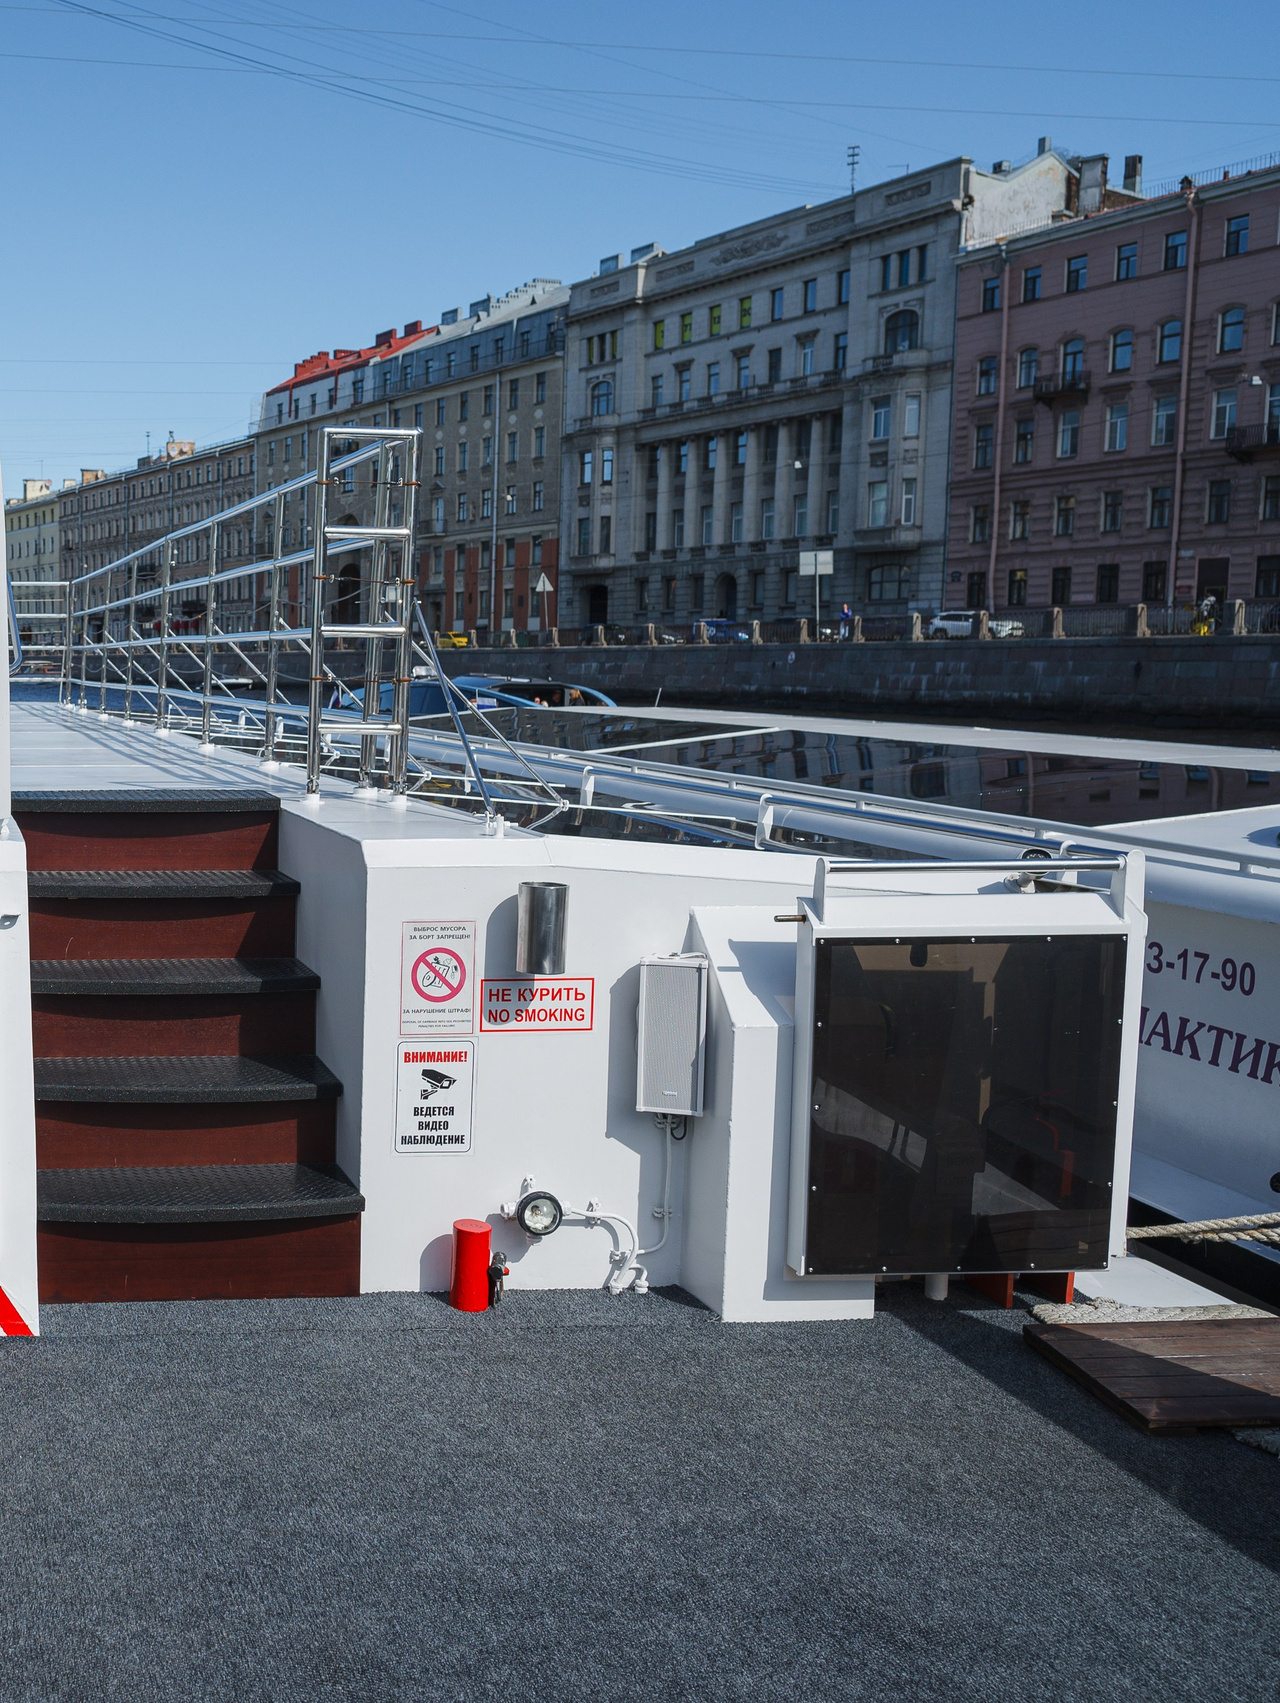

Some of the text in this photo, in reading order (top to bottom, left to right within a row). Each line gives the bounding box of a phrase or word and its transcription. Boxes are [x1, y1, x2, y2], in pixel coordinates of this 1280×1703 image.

[1146, 941, 1256, 996] 3-17-90
[488, 987, 586, 1002] НЕ КУРИТЬ
[488, 1008, 586, 1022] NO SMOKING
[403, 1050, 469, 1064] ВНИМАНИЕ!
[413, 1105, 455, 1118] ВЕДЕТСЯ
[417, 1120, 449, 1133] ВИДЕО
[400, 1134, 466, 1147] НАБЛЮДЕНИЕ
